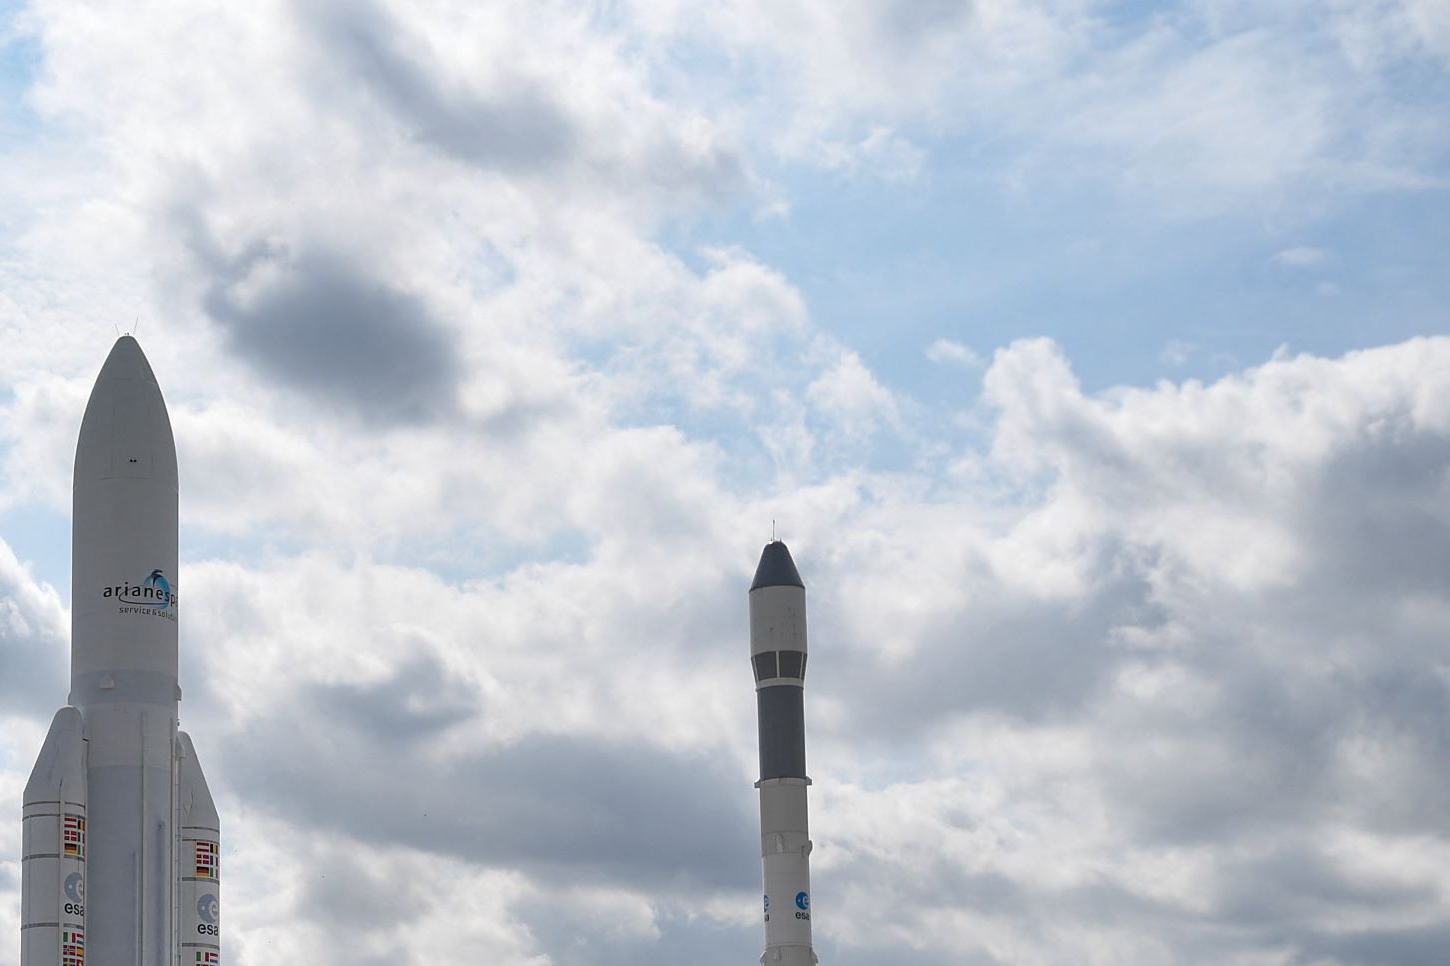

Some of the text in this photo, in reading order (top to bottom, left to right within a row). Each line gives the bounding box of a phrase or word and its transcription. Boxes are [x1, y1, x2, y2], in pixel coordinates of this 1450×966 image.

[103, 581, 176, 607] arianesp
[64, 903, 84, 916] esa
[197, 923, 218, 936] esa
